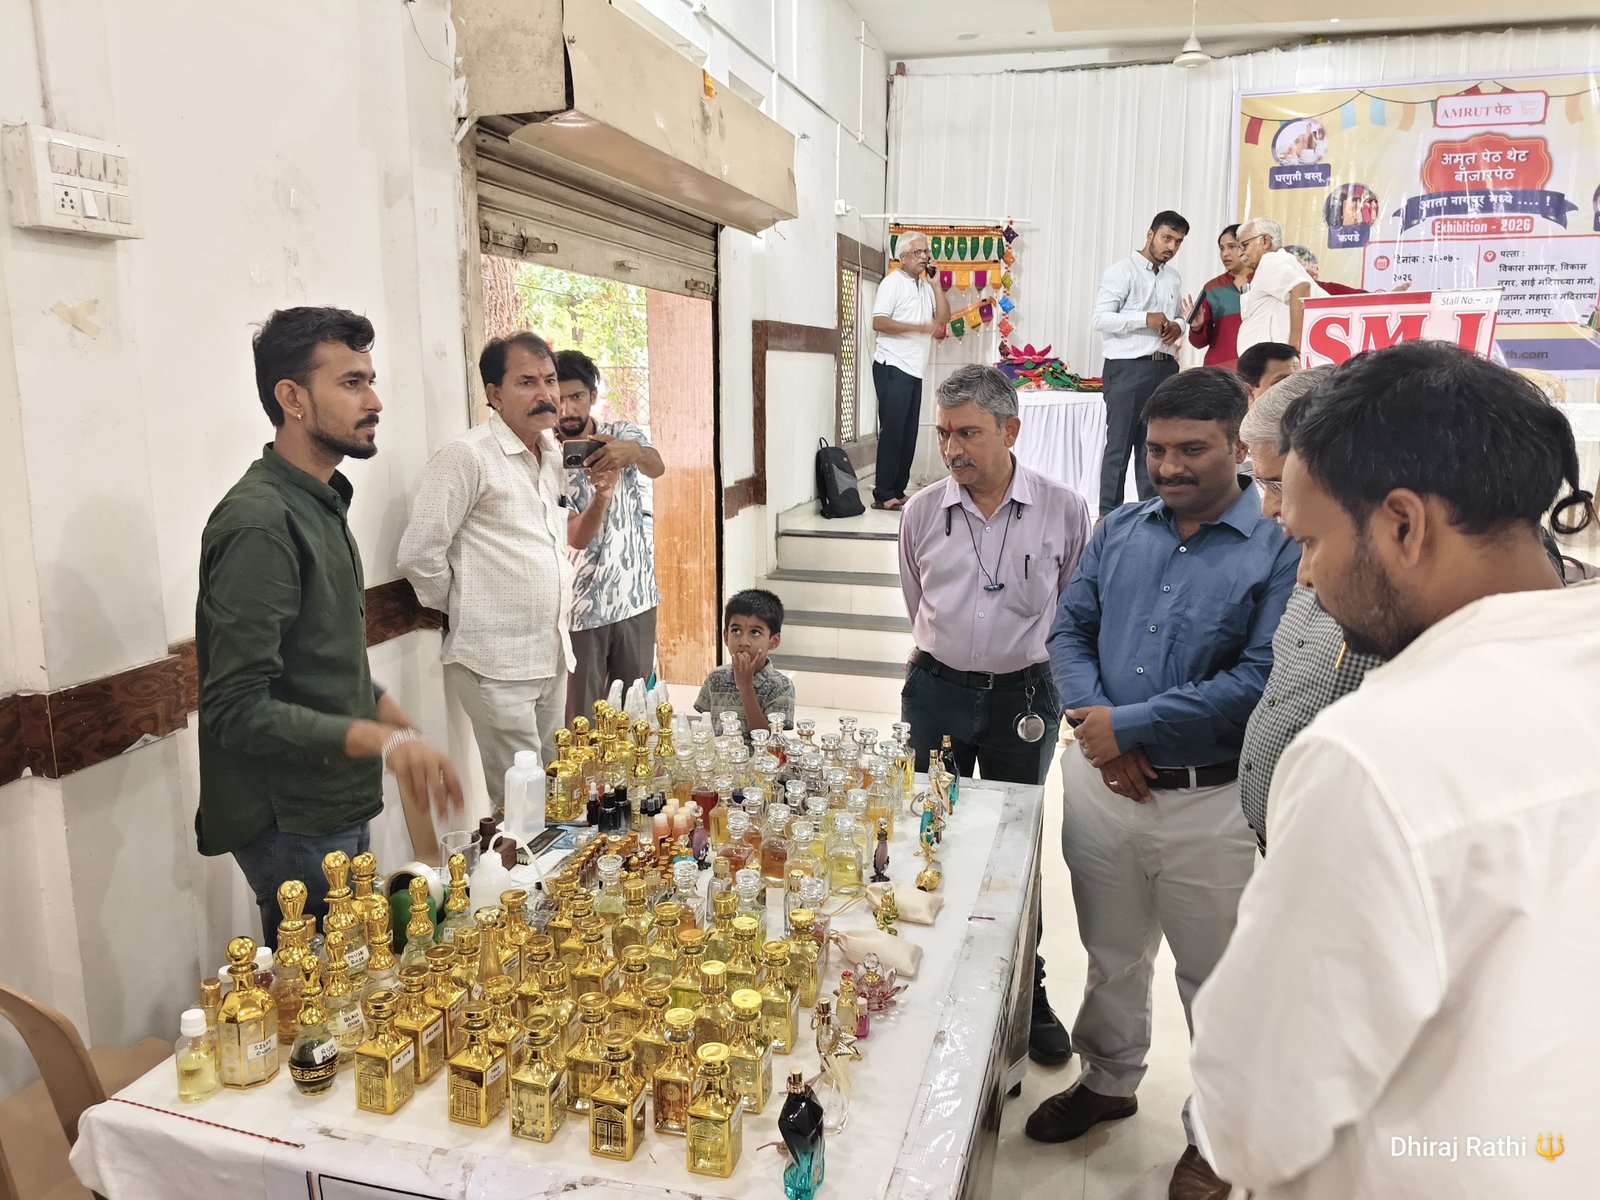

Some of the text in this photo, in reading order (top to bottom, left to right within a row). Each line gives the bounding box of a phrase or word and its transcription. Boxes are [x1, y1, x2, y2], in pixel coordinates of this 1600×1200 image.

[1441, 103, 1513, 119] AMRUT पेठ
[1481, 148, 1503, 163] पेठ
[1507, 147, 1529, 162] थेट
[1275, 171, 1326, 185] घरगुती वस्तू
[1434, 220, 1488, 234] Exhibition
[1500, 219, 1531, 232] 2026
[1338, 231, 1360, 242] कपडे
[1499, 263, 1525, 272] विकास
[1560, 262, 1587, 270] विकास
[1441, 296, 1459, 305] Stall
